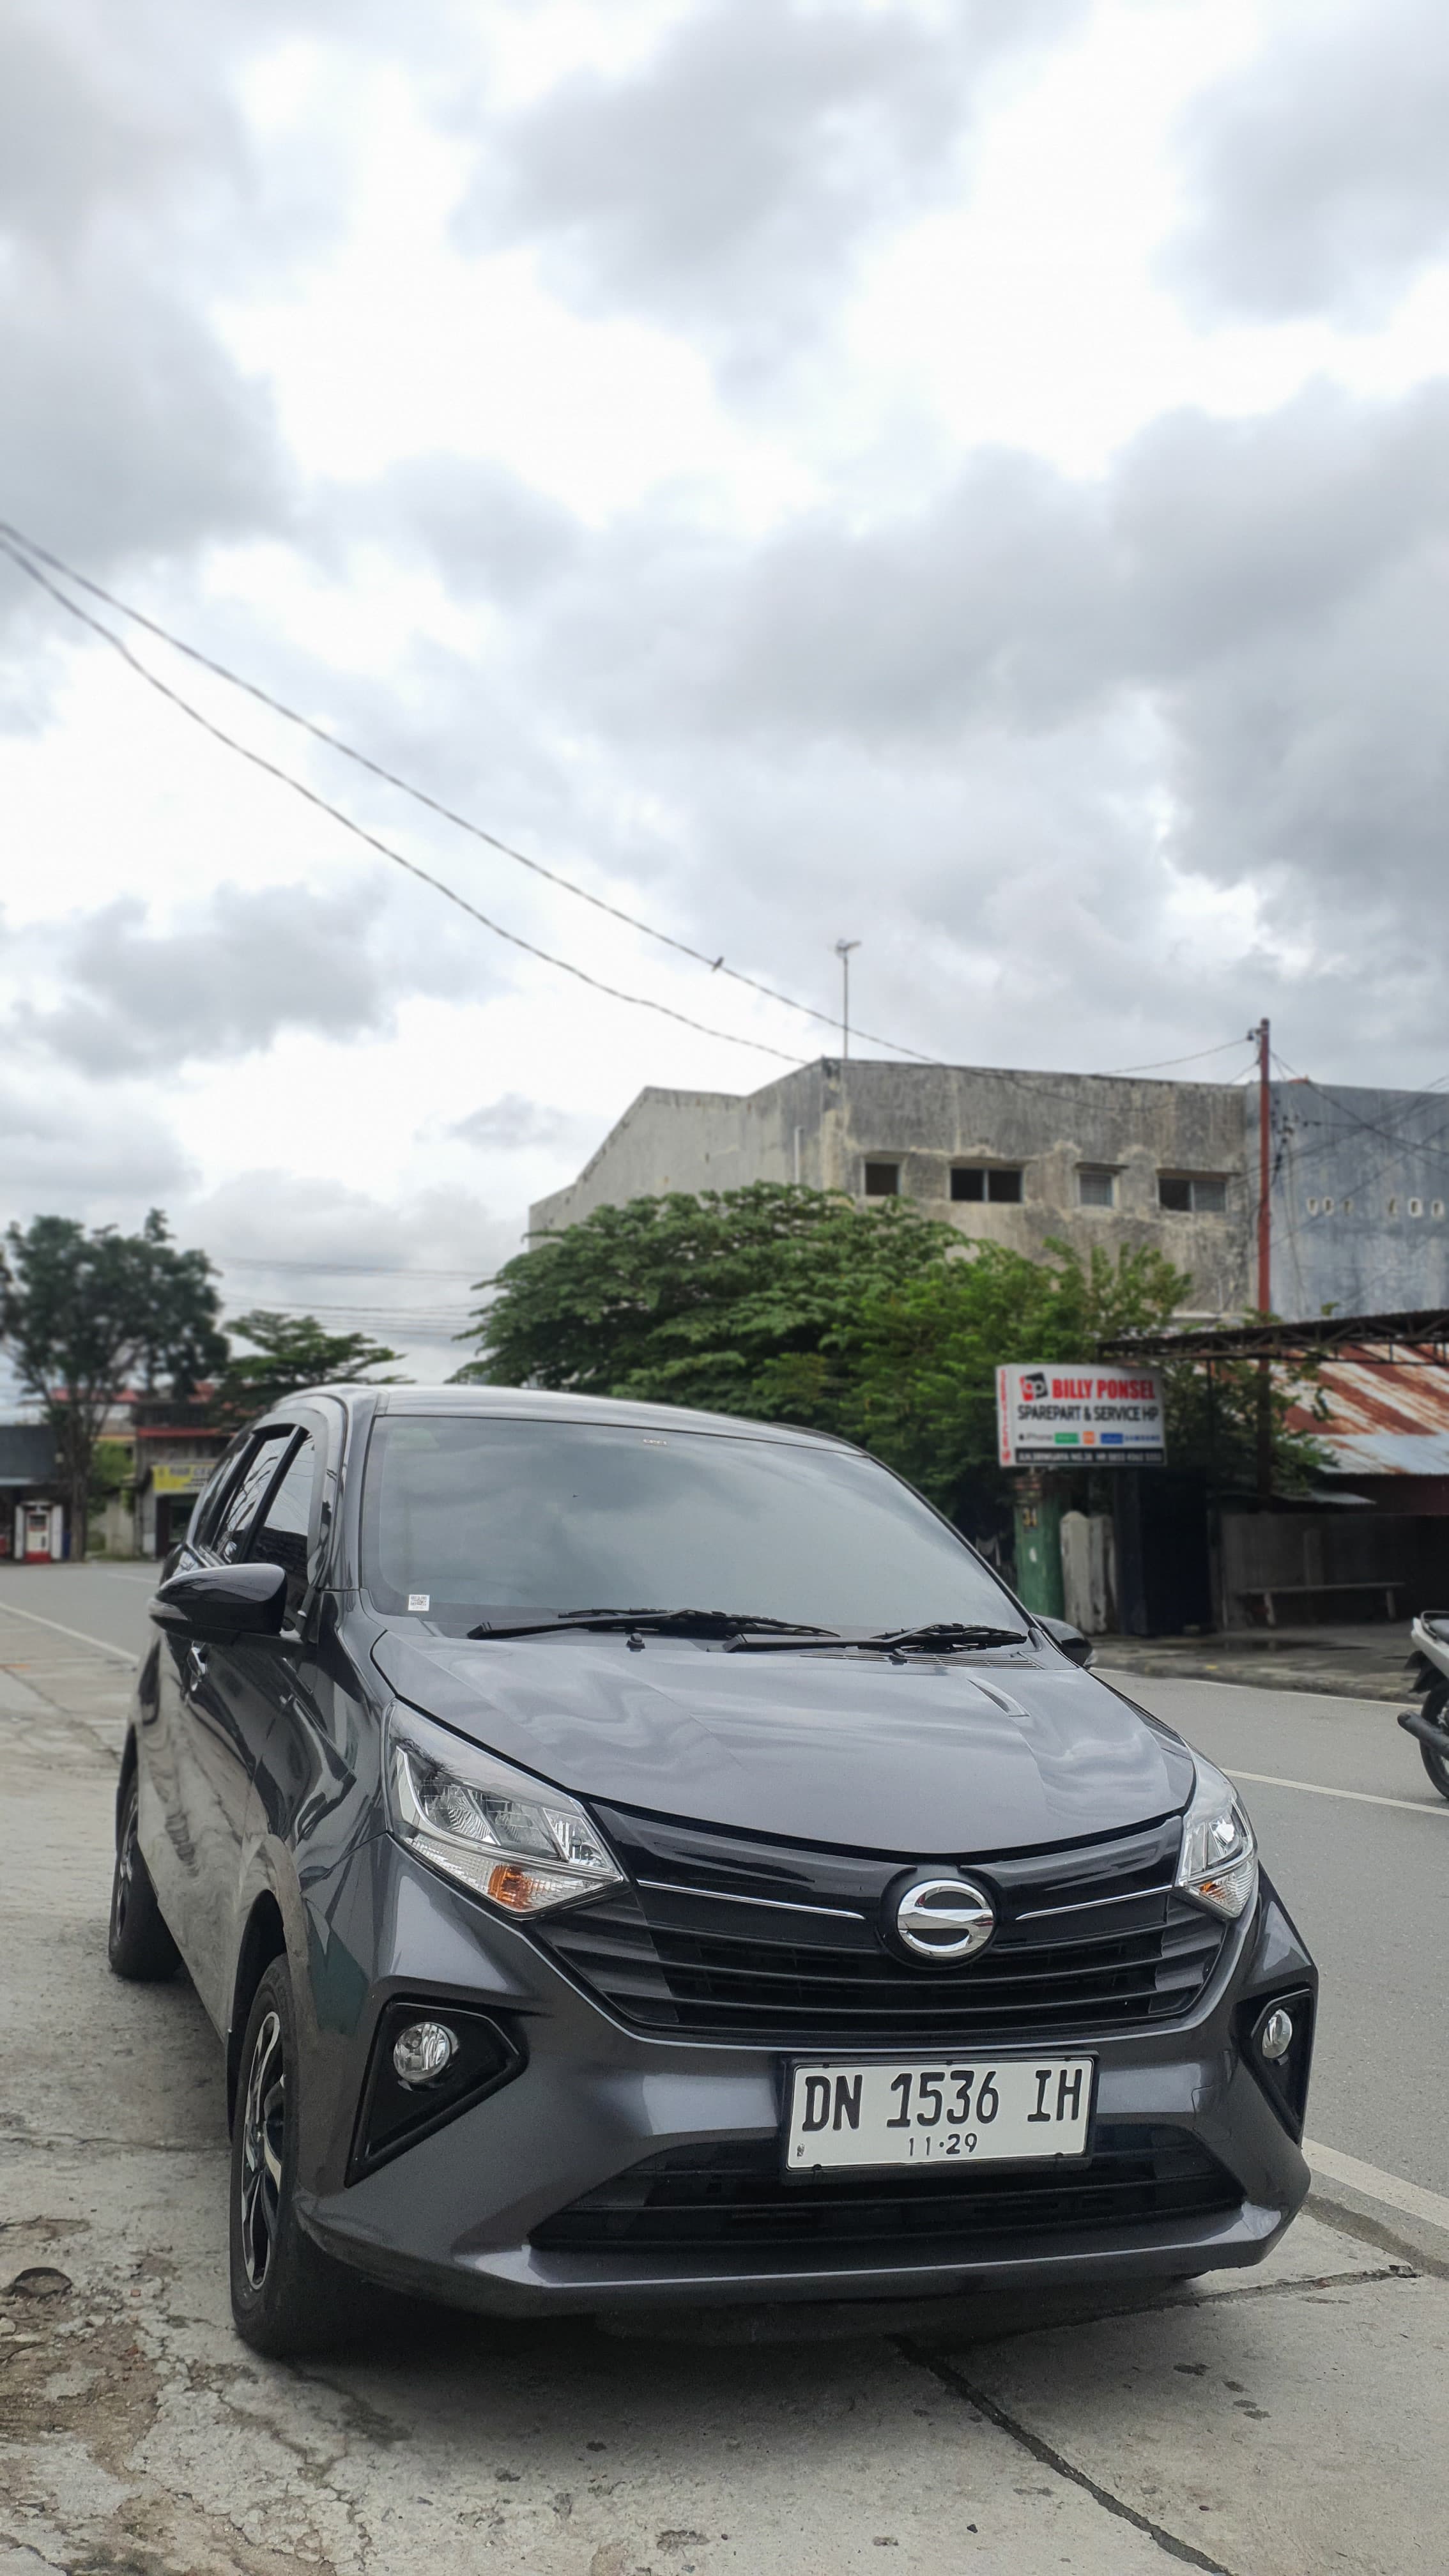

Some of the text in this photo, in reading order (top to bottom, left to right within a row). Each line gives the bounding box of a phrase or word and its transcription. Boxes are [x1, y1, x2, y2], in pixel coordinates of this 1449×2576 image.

[1052, 1378, 1156, 1400] BILLY PONSEL
[1018, 1405, 1159, 1422] SPAREPART & SERVICE HP
[802, 2068, 1083, 2132] DN 1536 IH
